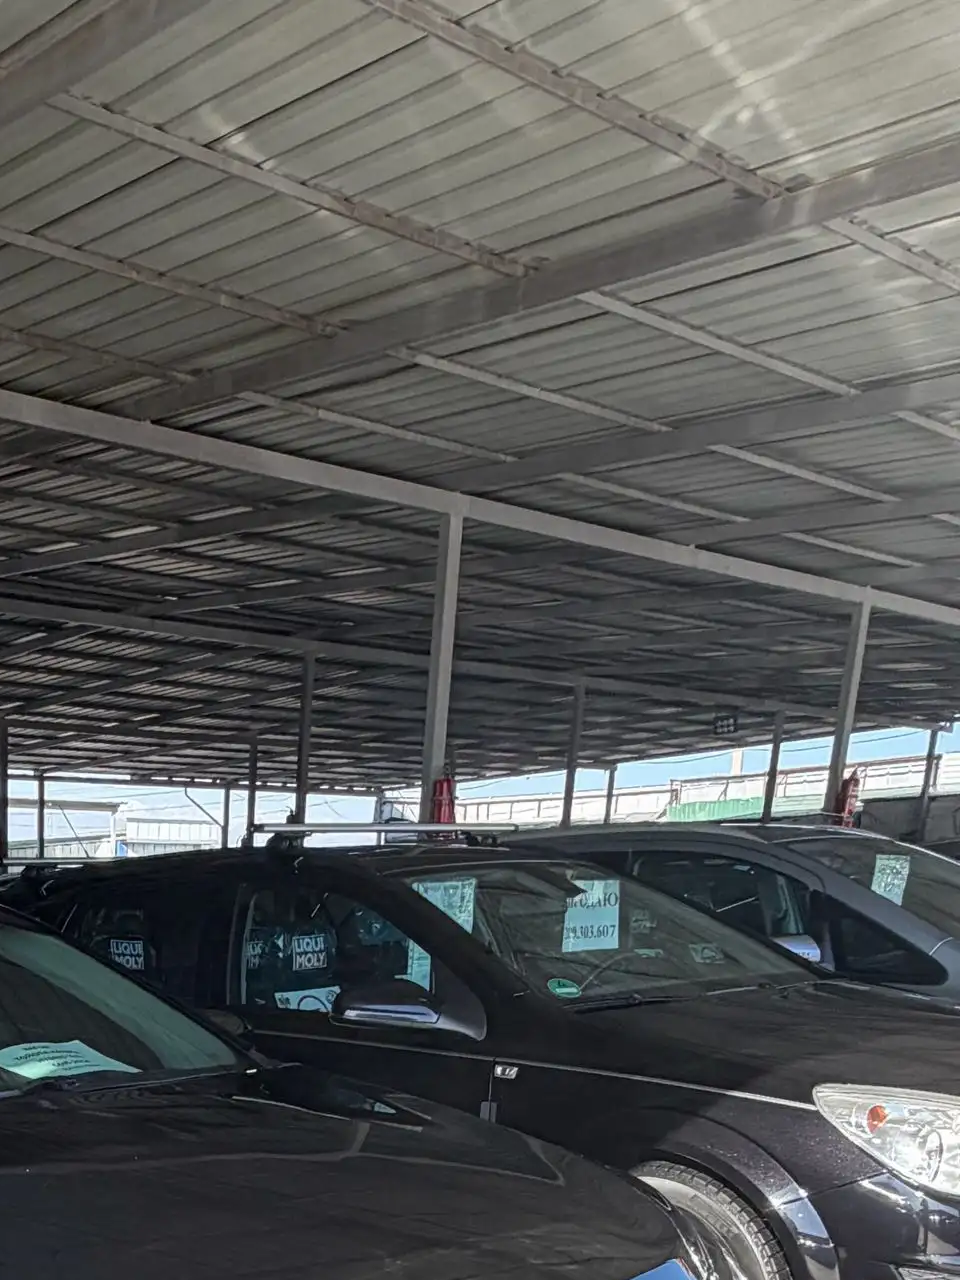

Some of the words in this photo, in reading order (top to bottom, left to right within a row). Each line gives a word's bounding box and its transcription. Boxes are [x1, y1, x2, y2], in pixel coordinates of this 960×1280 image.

[113, 942, 142, 955] LIQUI
[295, 937, 325, 952] LIQUI
[296, 952, 326, 968] MOLY
